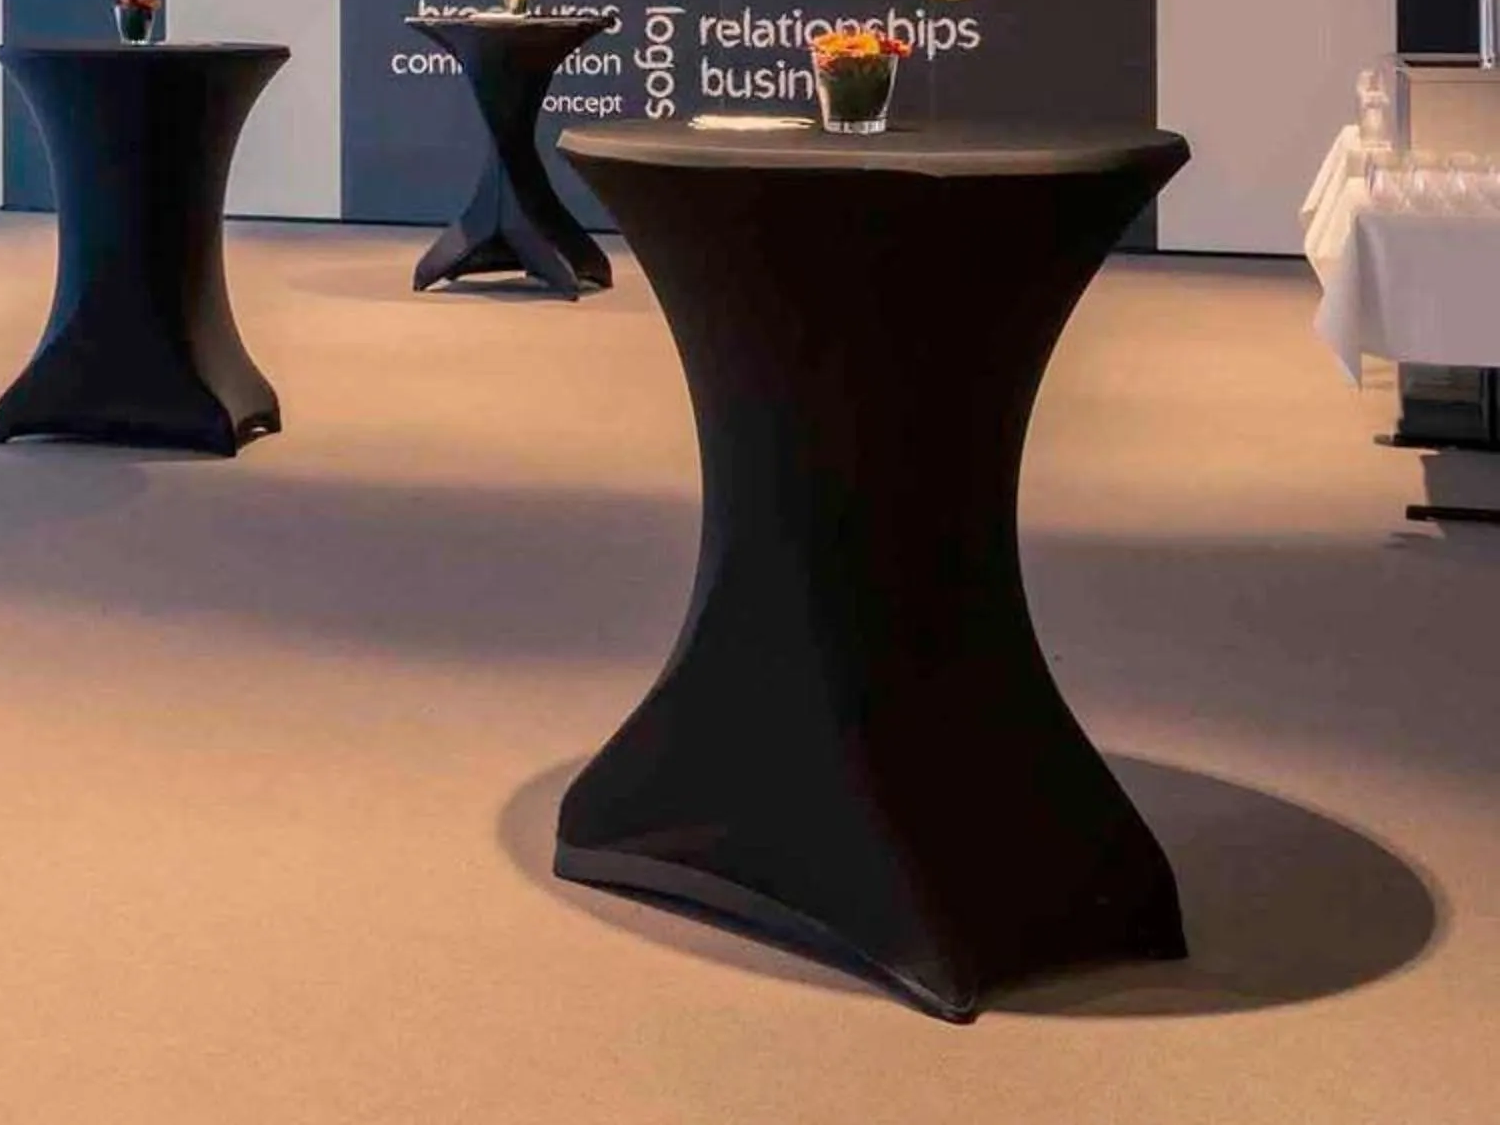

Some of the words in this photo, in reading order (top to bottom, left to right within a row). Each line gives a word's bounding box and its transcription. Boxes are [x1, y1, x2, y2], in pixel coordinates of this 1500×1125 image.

[634, 6, 686, 119] logos
[700, 58, 814, 101] busin
[542, 94, 623, 118] oncept
